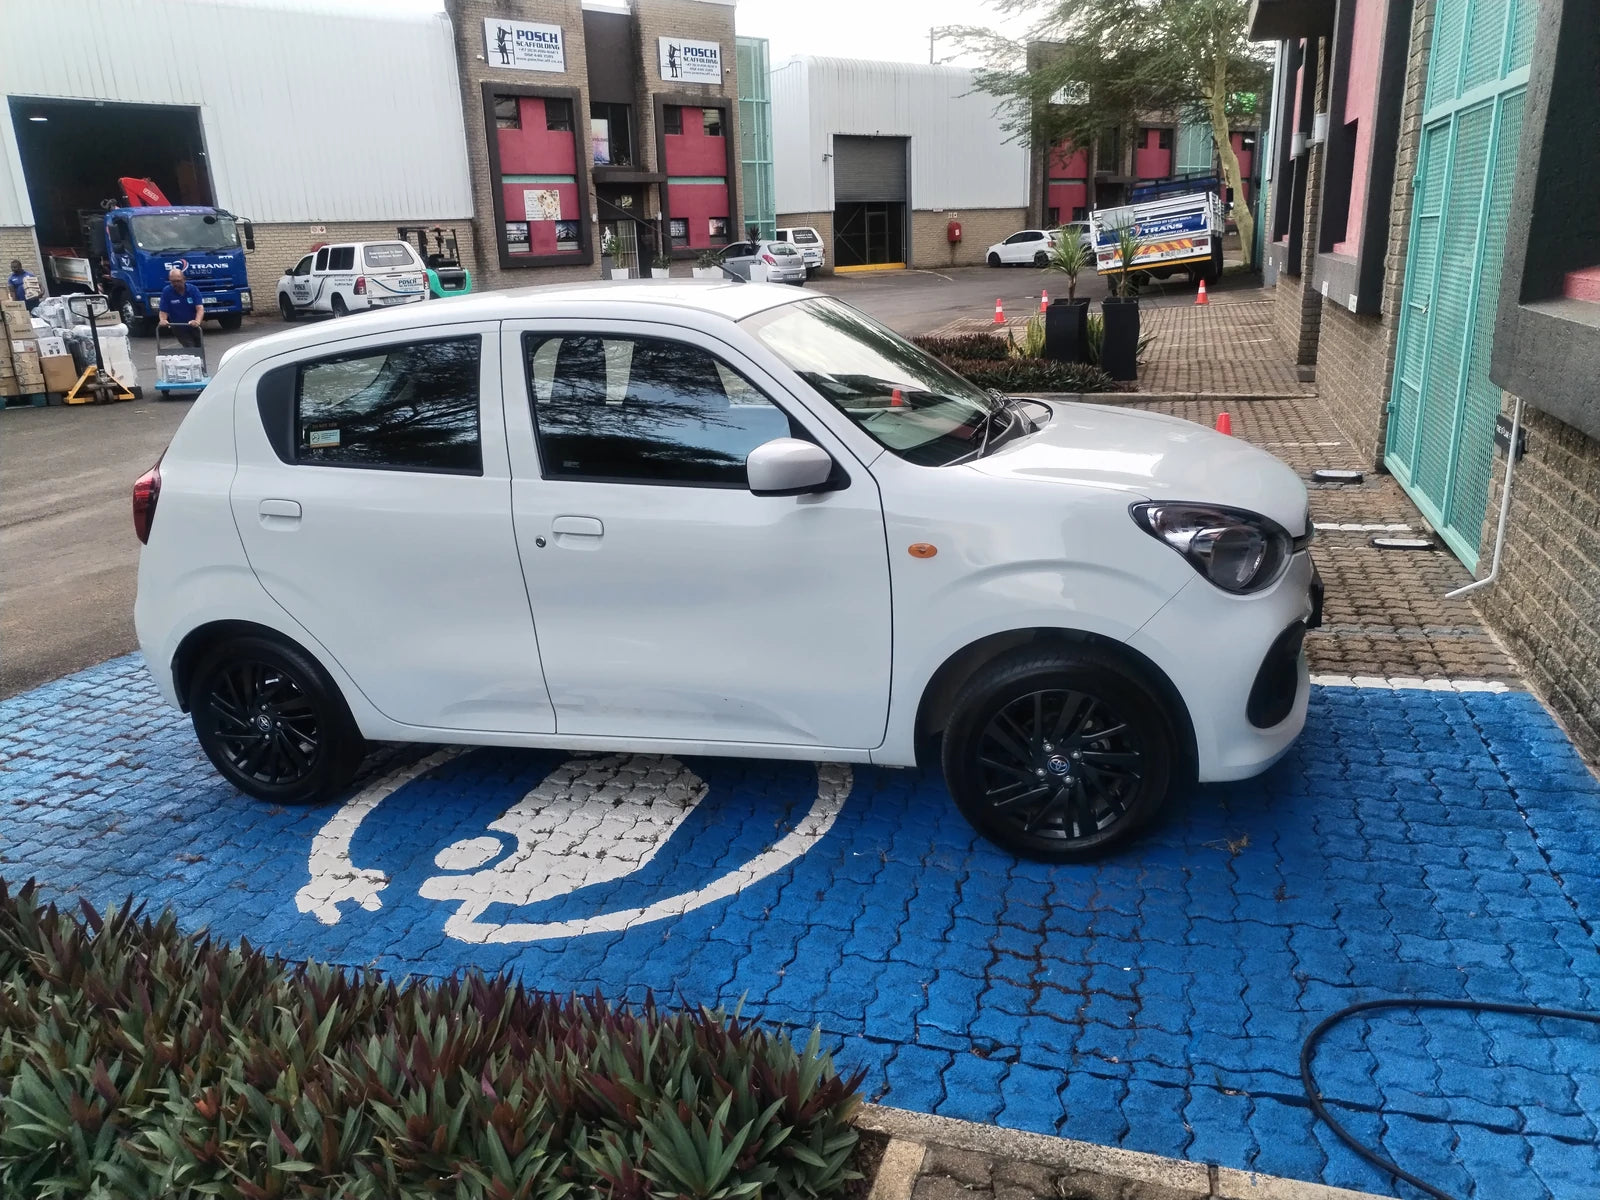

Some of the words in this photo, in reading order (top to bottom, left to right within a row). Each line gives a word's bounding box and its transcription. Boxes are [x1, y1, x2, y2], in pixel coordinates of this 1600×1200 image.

[516, 29, 558, 43] POSCH
[516, 41, 560, 50] SCAFFOLDING
[683, 46, 717, 58] POSCH
[1143, 223, 1183, 233] TRANS
